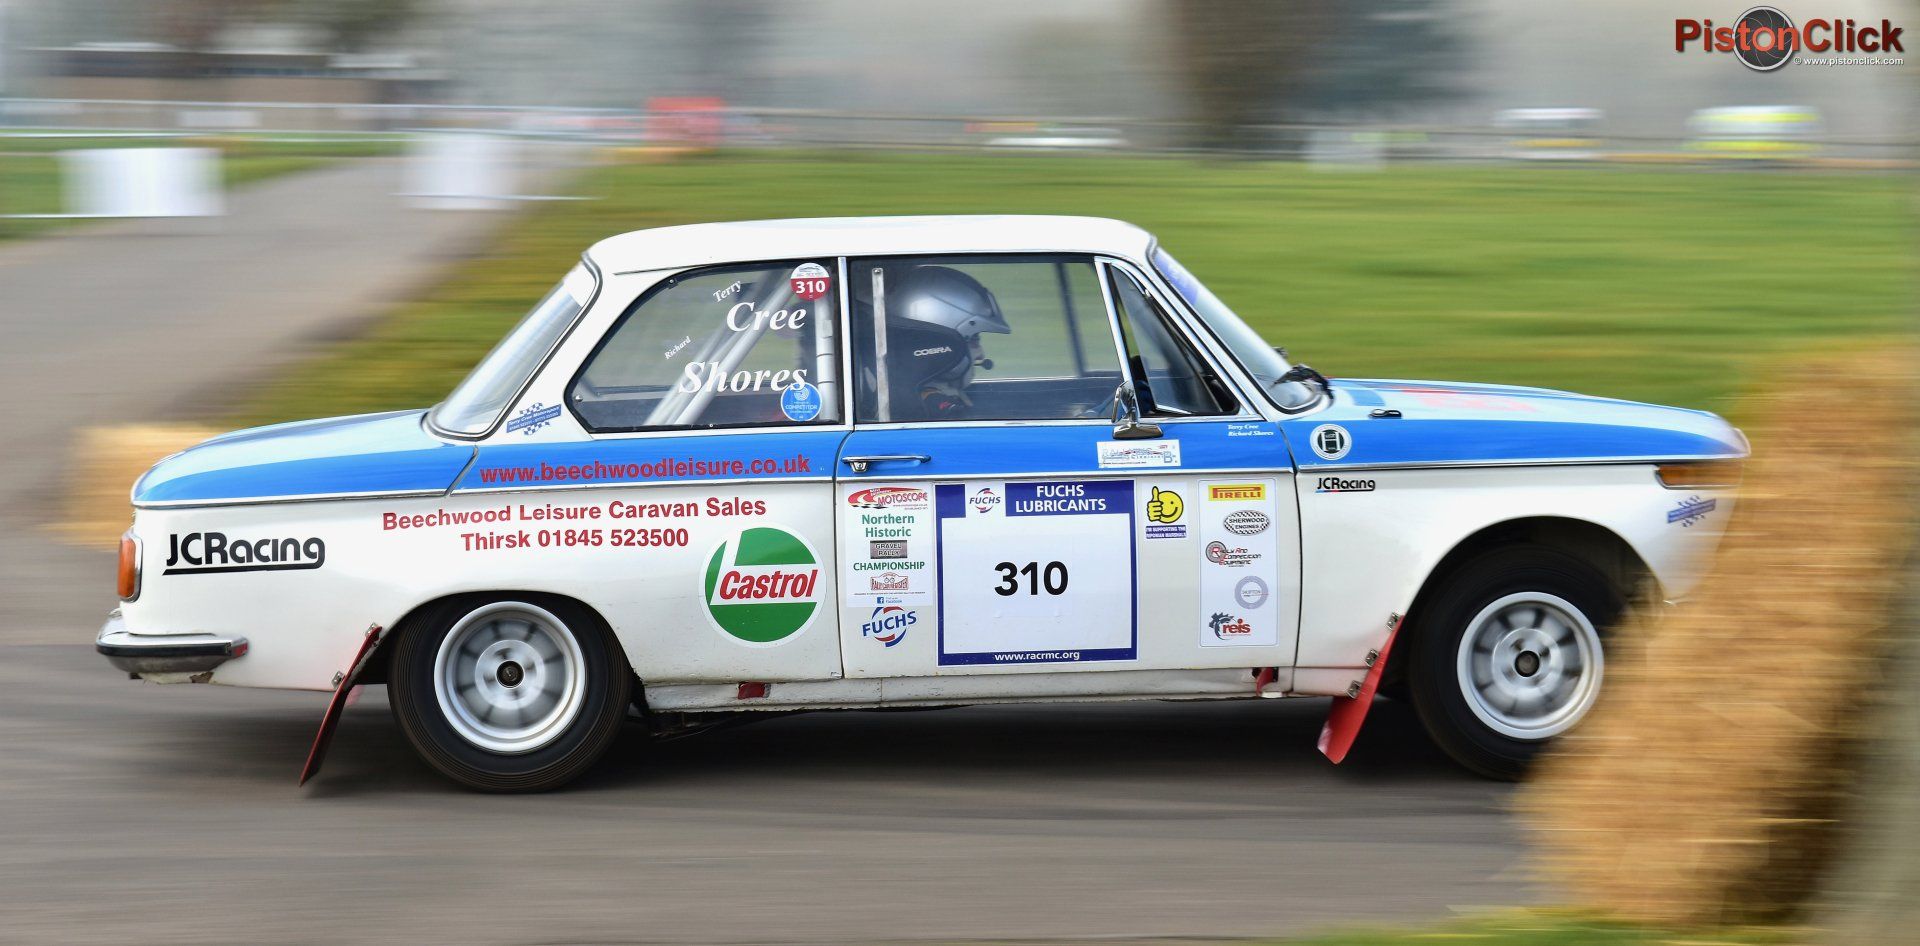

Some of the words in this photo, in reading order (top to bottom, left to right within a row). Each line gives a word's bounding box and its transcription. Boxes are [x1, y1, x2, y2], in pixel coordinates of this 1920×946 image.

[712, 280, 741, 302] Terry
[795, 280, 826, 294] 310
[726, 302, 807, 332] Cree
[664, 336, 691, 360] Richard
[913, 346, 952, 357] COBRA
[678, 361, 807, 394] Shores
[479, 454, 811, 483] www.beechwoodleisure.co.uk
[1036, 484, 1085, 498] FUCHS
[1316, 477, 1376, 492] JCRacing
[878, 492, 928, 505] MOTOSCOPE
[1212, 486, 1262, 499] PIRELLI
[969, 496, 1001, 505] FUCHS
[1015, 499, 1107, 513] LUBRICANTS
[382, 506, 511, 531] Beechwood
[520, 503, 601, 521] Leisure
[608, 499, 699, 519] Caravan
[706, 497, 767, 517] Sales
[862, 514, 915, 524] Northern
[461, 531, 531, 551] Thirsk
[538, 529, 603, 547] 01845
[610, 528, 689, 547] 523500
[865, 527, 912, 537] Historic
[163, 532, 325, 575] JCRacing
[853, 561, 925, 571] CHAMPIONSHIP
[719, 569, 819, 600] Castrol
[994, 560, 1069, 596] 310
[862, 611, 917, 637] FUCHS
[1222, 618, 1251, 633] reis
[994, 651, 1080, 662] www.racrmc.org
